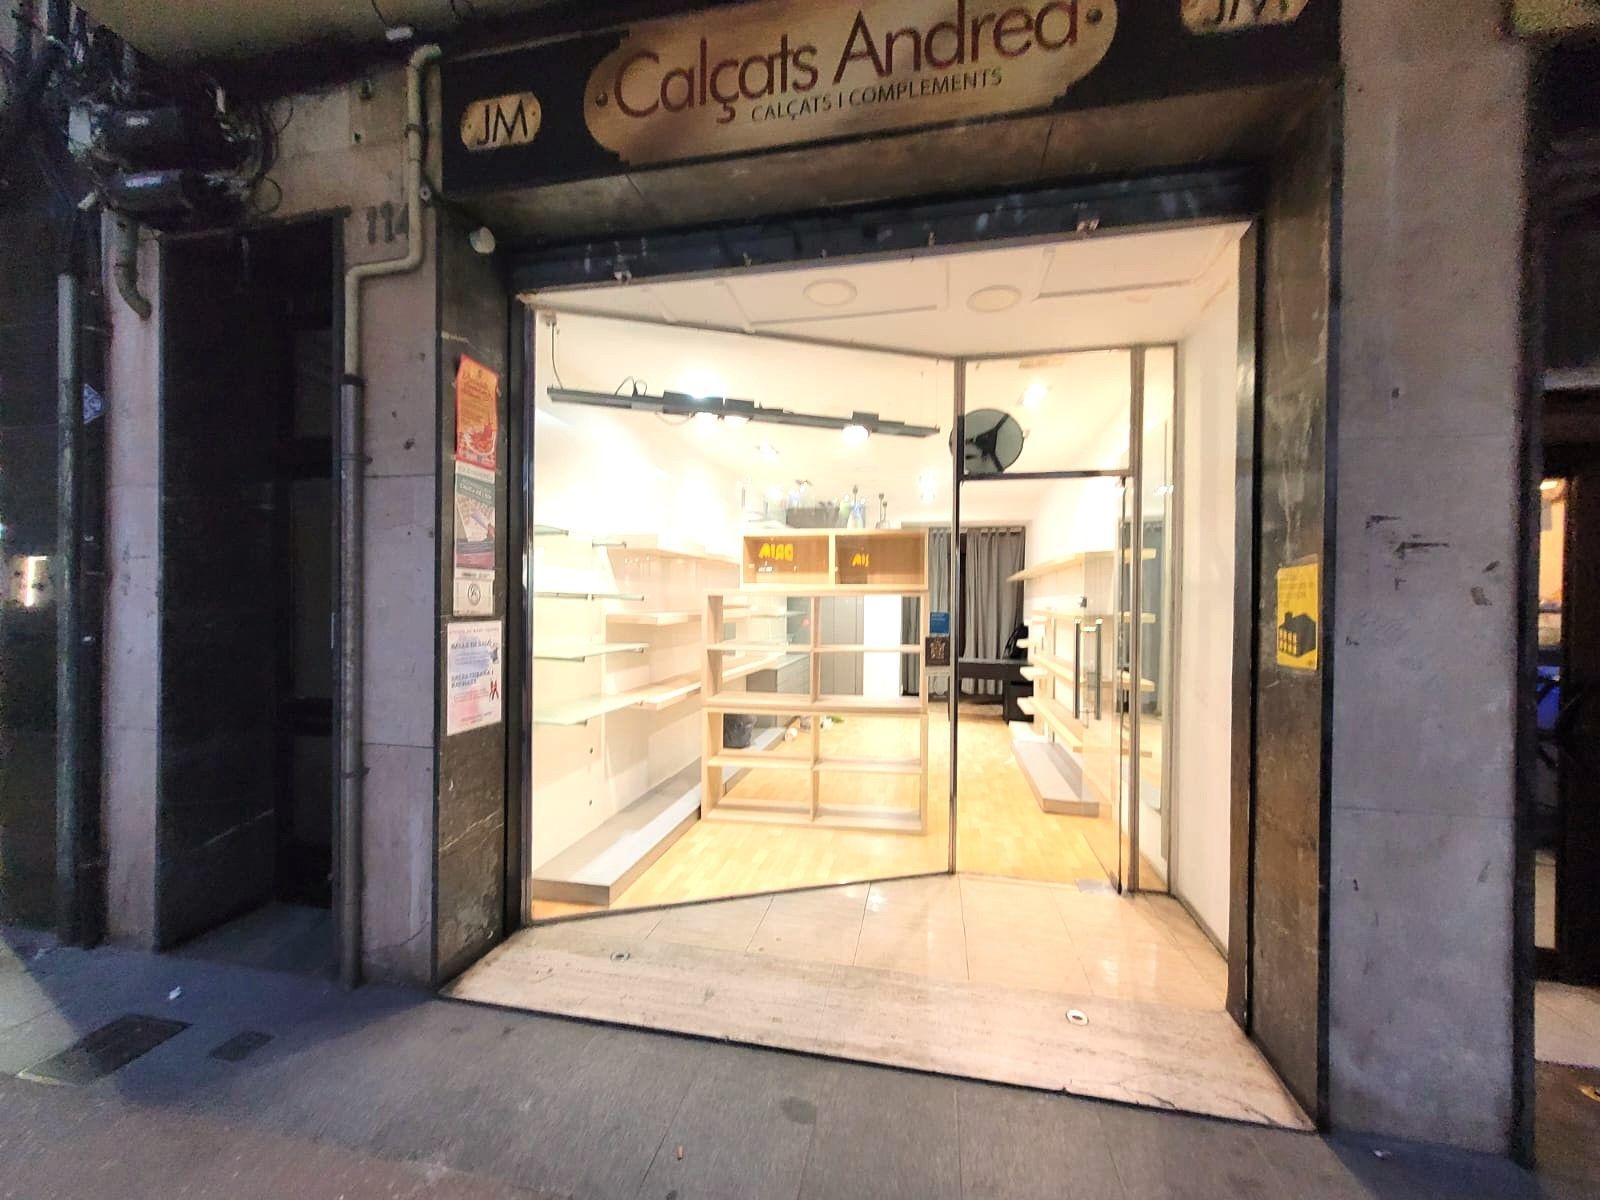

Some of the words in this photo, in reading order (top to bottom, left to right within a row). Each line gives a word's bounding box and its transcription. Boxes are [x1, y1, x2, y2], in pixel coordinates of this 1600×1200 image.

[614, 35, 819, 124] Calçats
[751, 93, 831, 121] CALÇATS
[837, 89, 844, 109] I
[849, 68, 1003, 108] COMPLEMENTS
[477, 99, 528, 146] JM
